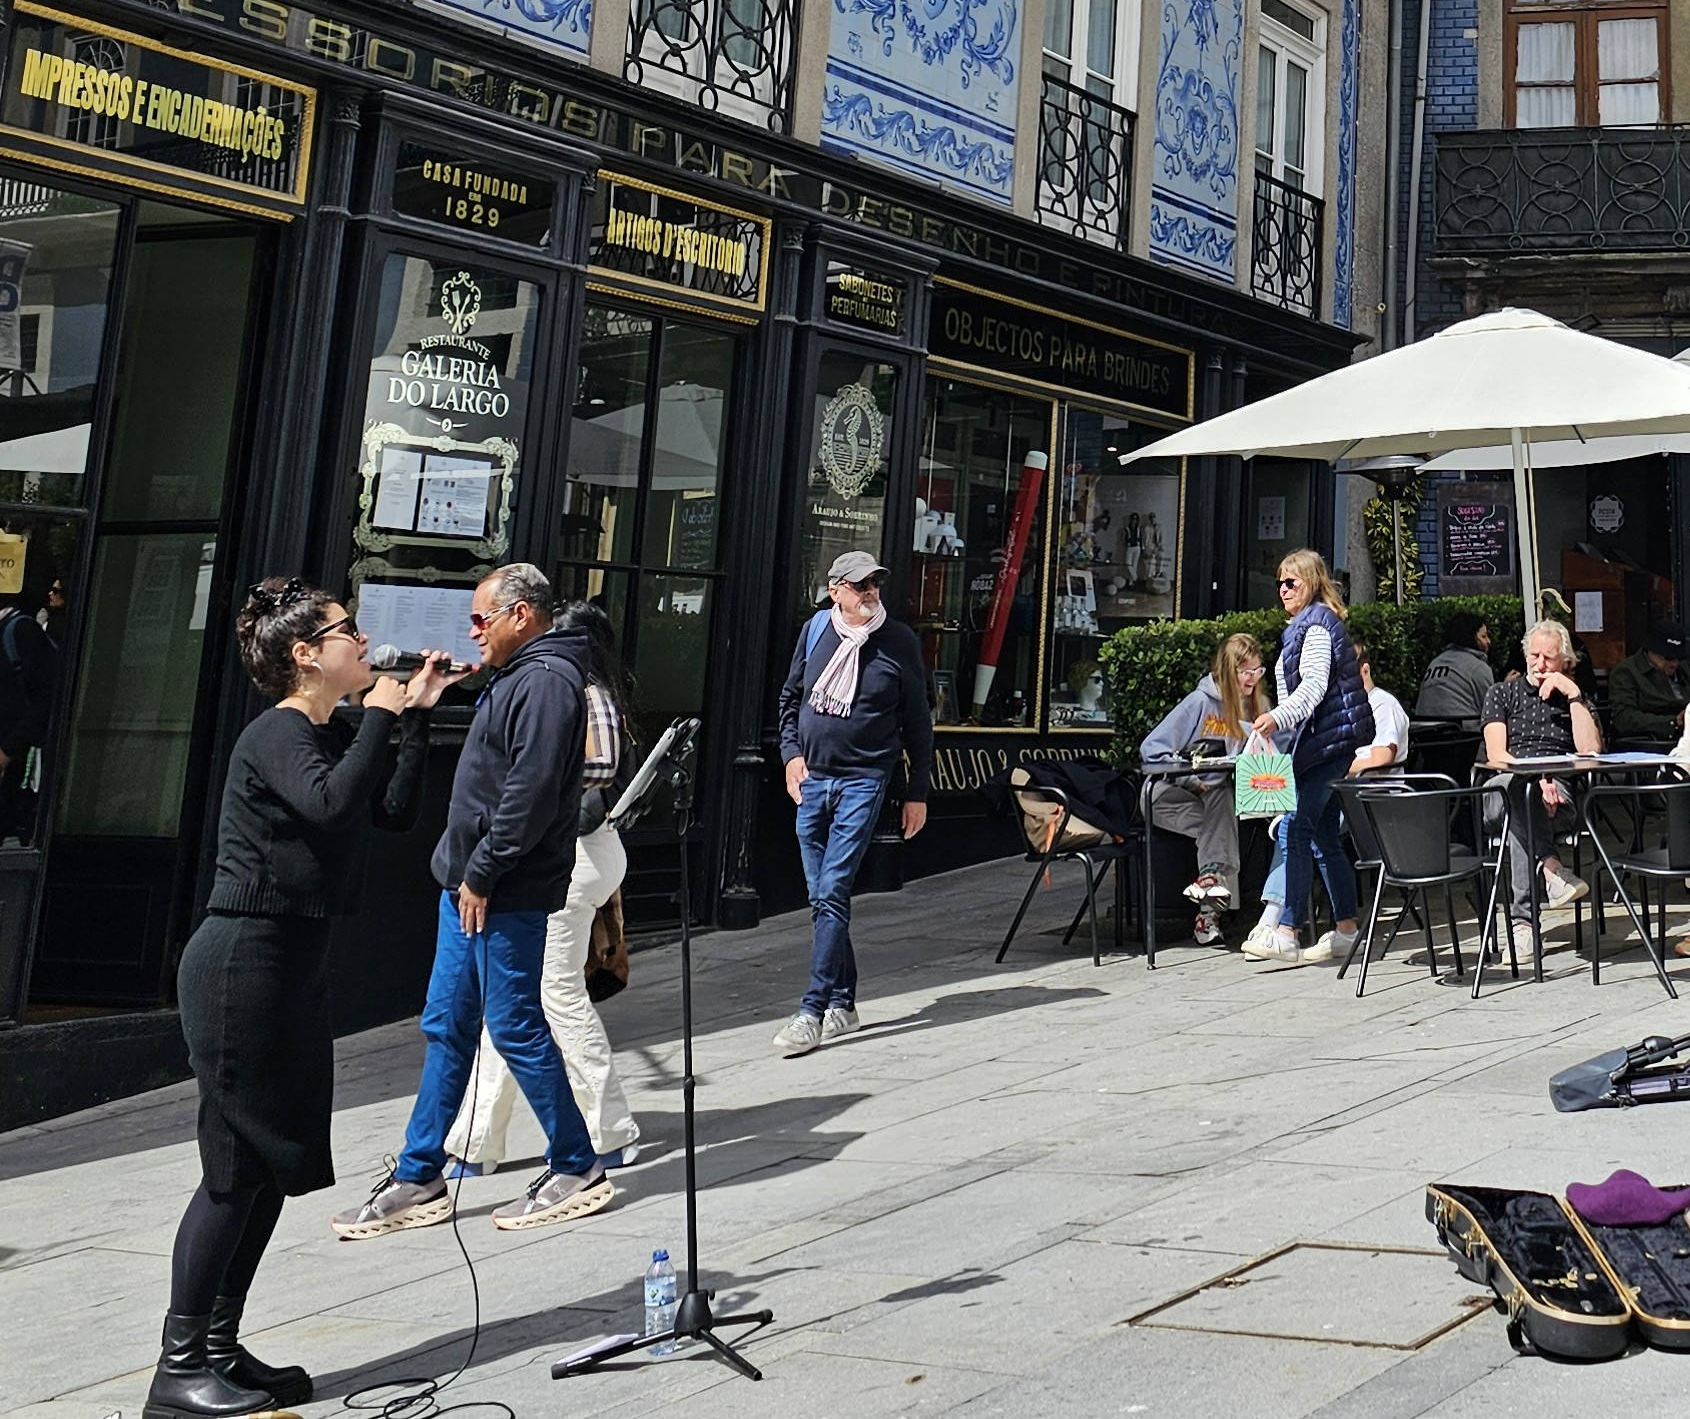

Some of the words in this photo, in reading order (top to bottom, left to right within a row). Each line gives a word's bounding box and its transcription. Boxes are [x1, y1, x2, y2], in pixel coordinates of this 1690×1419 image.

[20, 48, 132, 120] IMPRESSOS
[131, 80, 148, 125] E
[146, 83, 285, 164] ENCADERNAÇÕES
[423, 159, 461, 187] CASA
[464, 171, 527, 204] FUNDADA
[445, 196, 500, 227] 1829
[632, 122, 792, 199] PARA
[822, 182, 1040, 274] DESENHO
[1059, 261, 1080, 287] E
[607, 207, 662, 255] ARTIGOS
[662, 222, 745, 277] D'ESCRITORIO
[839, 273, 894, 303] SABONETES
[831, 295, 897, 327] PERFUMARIAS
[420, 334, 491, 360] RESTAURANTE
[945, 308, 1044, 363] OBJECTOS
[1049, 336, 1098, 379] PARA
[1104, 351, 1171, 395] BRINDES
[401, 350, 501, 389] GALERIA
[387, 377, 425, 406] DO
[430, 383, 510, 417] LARGO
